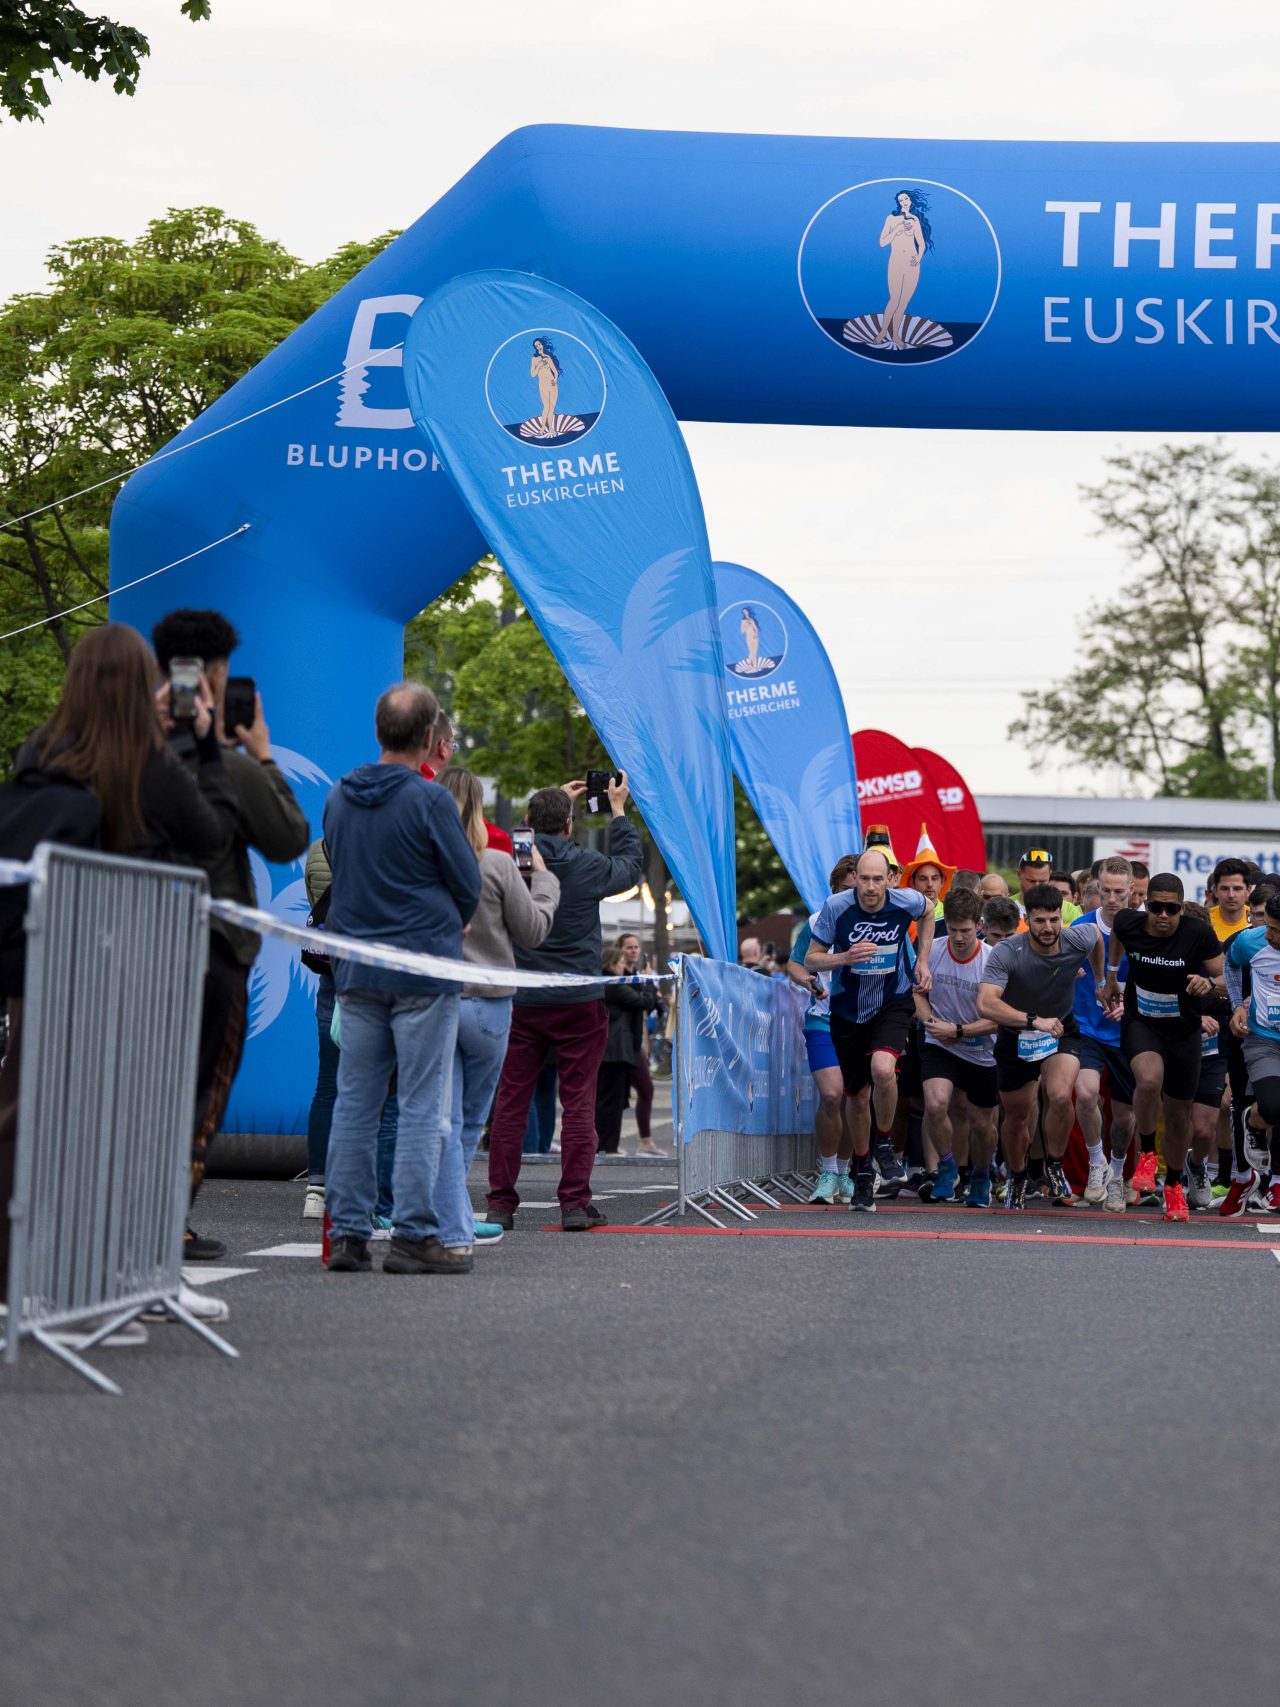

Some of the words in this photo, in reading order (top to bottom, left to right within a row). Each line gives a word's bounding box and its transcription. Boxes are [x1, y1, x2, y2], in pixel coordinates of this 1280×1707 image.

[501, 451, 621, 487] THERME
[506, 478, 625, 508] EUSKIRCHEN
[726, 680, 798, 706] THERME
[727, 697, 800, 719] EUSKIRCHEN
[848, 921, 900, 943] Ford
[1141, 956, 1185, 967] multicash
